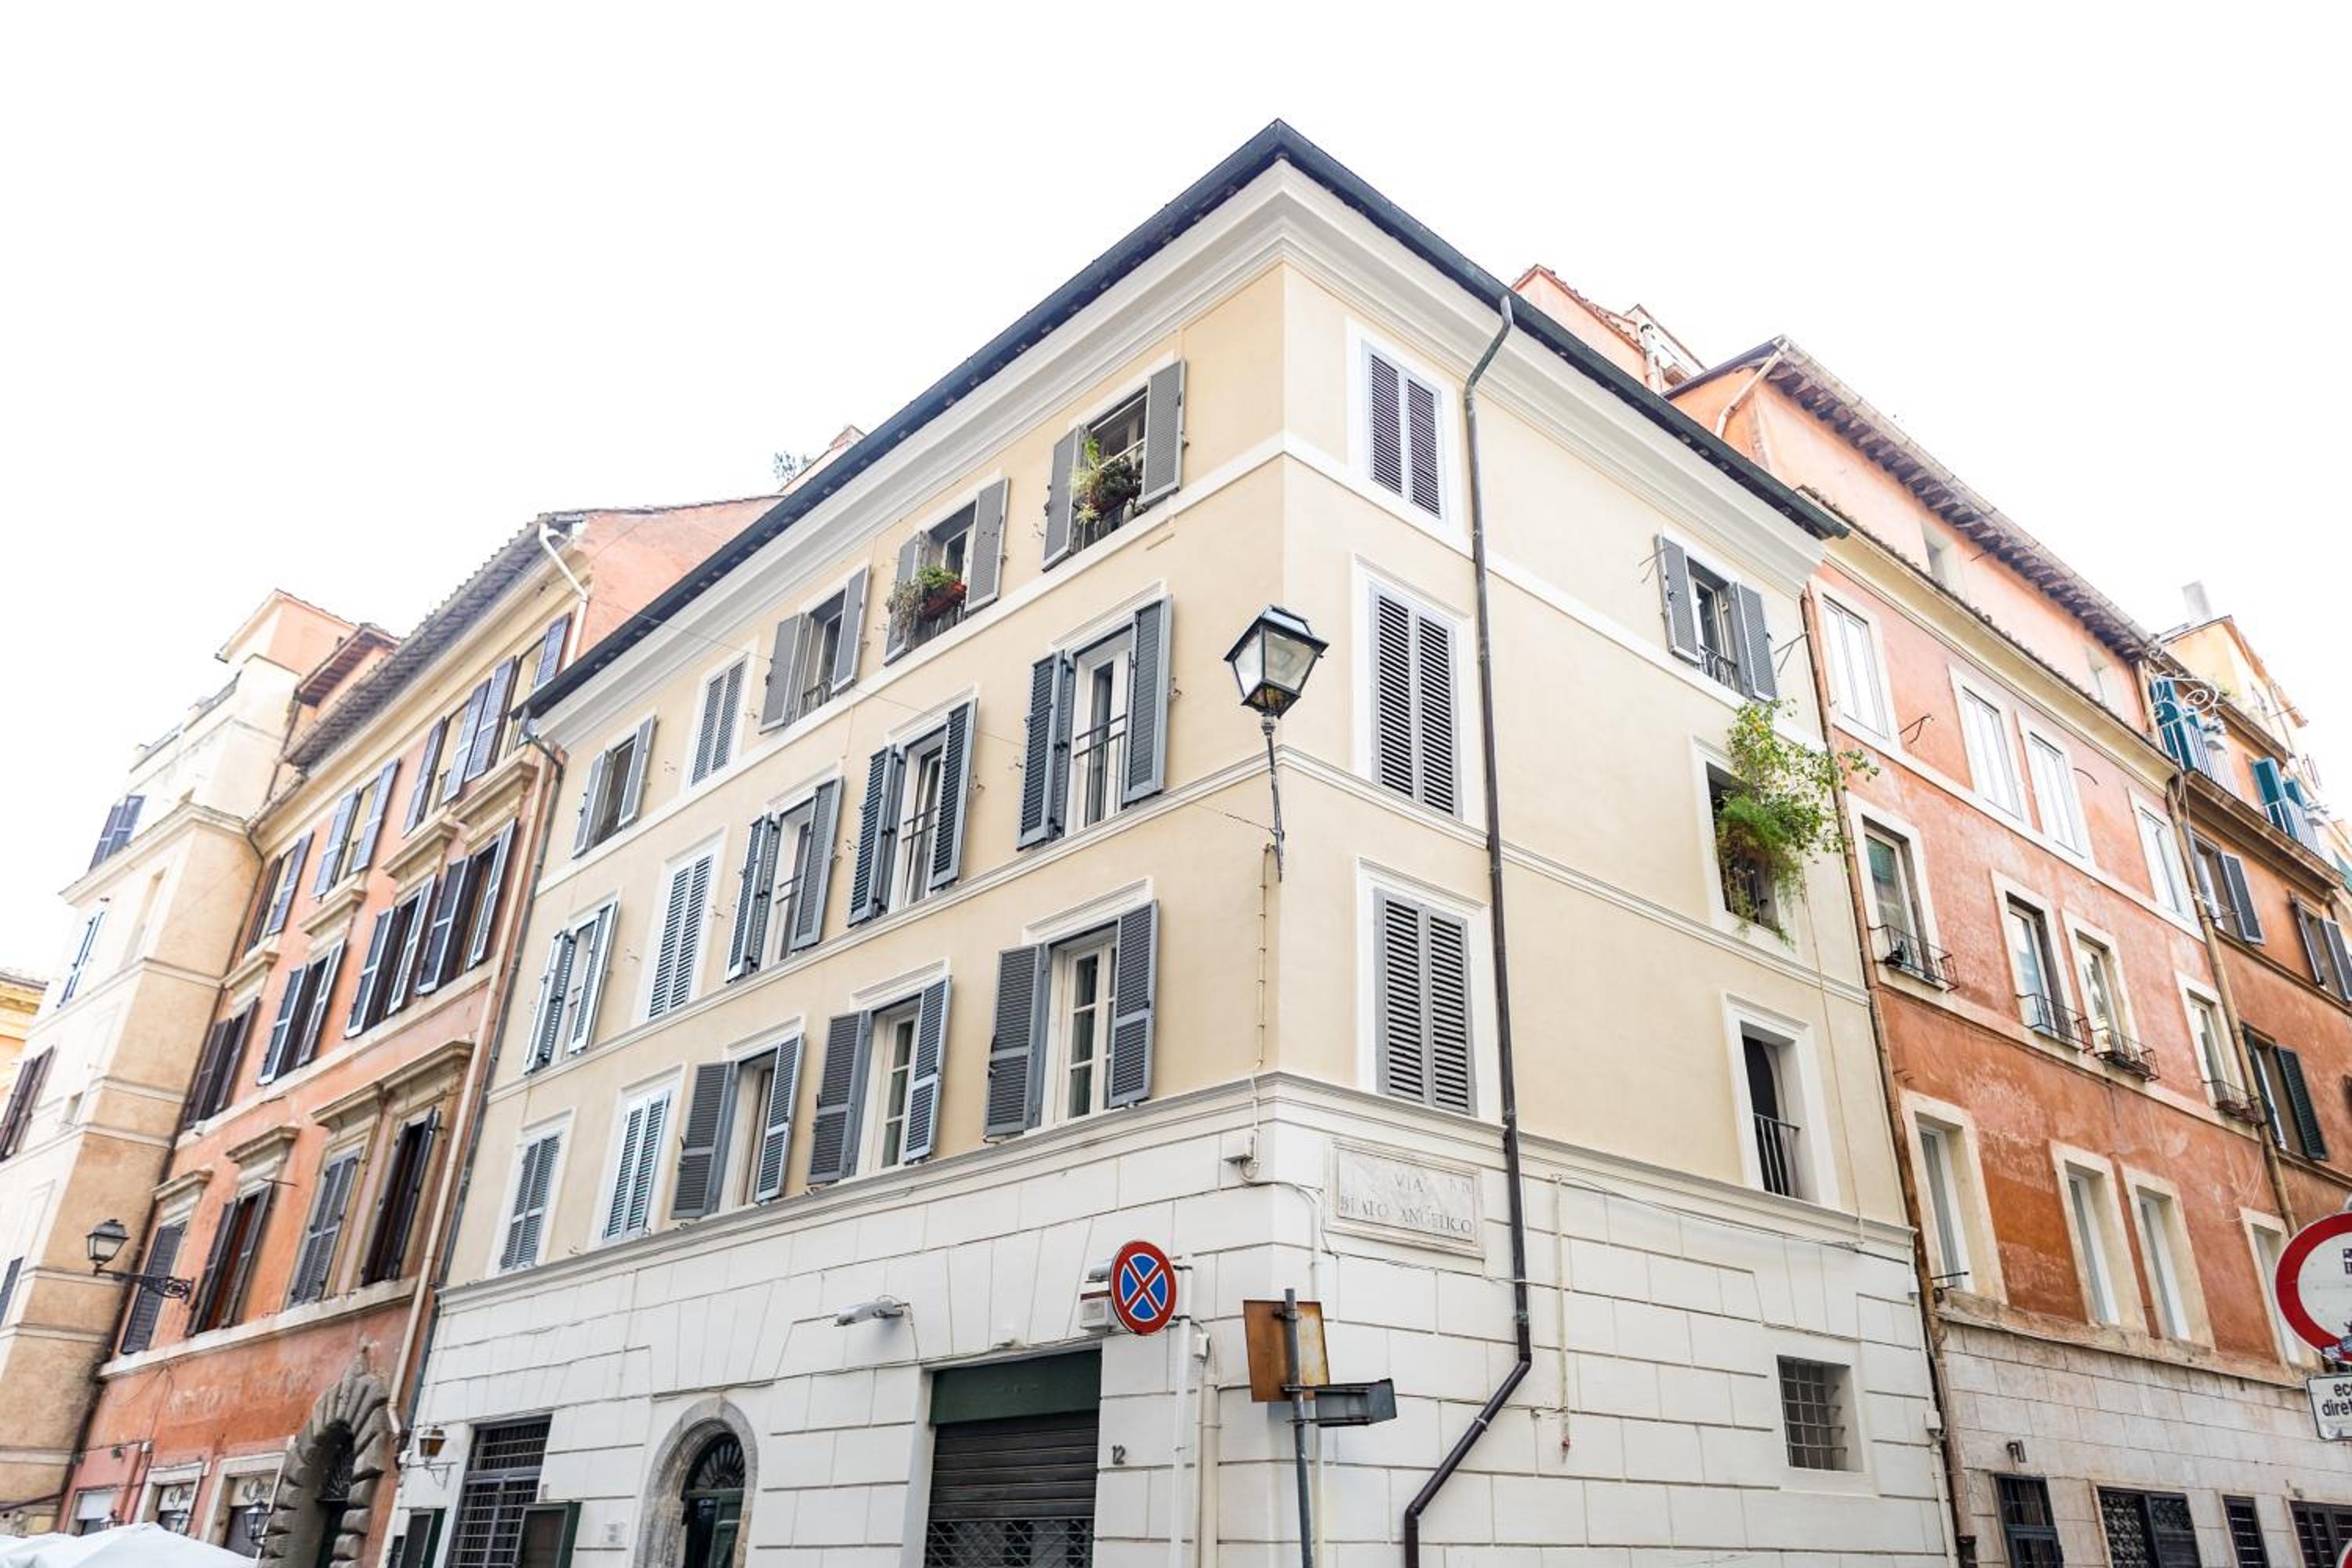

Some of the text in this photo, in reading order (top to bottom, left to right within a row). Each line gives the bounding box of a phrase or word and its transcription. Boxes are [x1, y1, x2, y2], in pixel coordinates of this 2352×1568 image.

[1395, 1174, 1424, 1192] VIA
[1340, 1195, 1473, 1234] BEATO ANGELICO
[1112, 1444, 1126, 1465] 12
